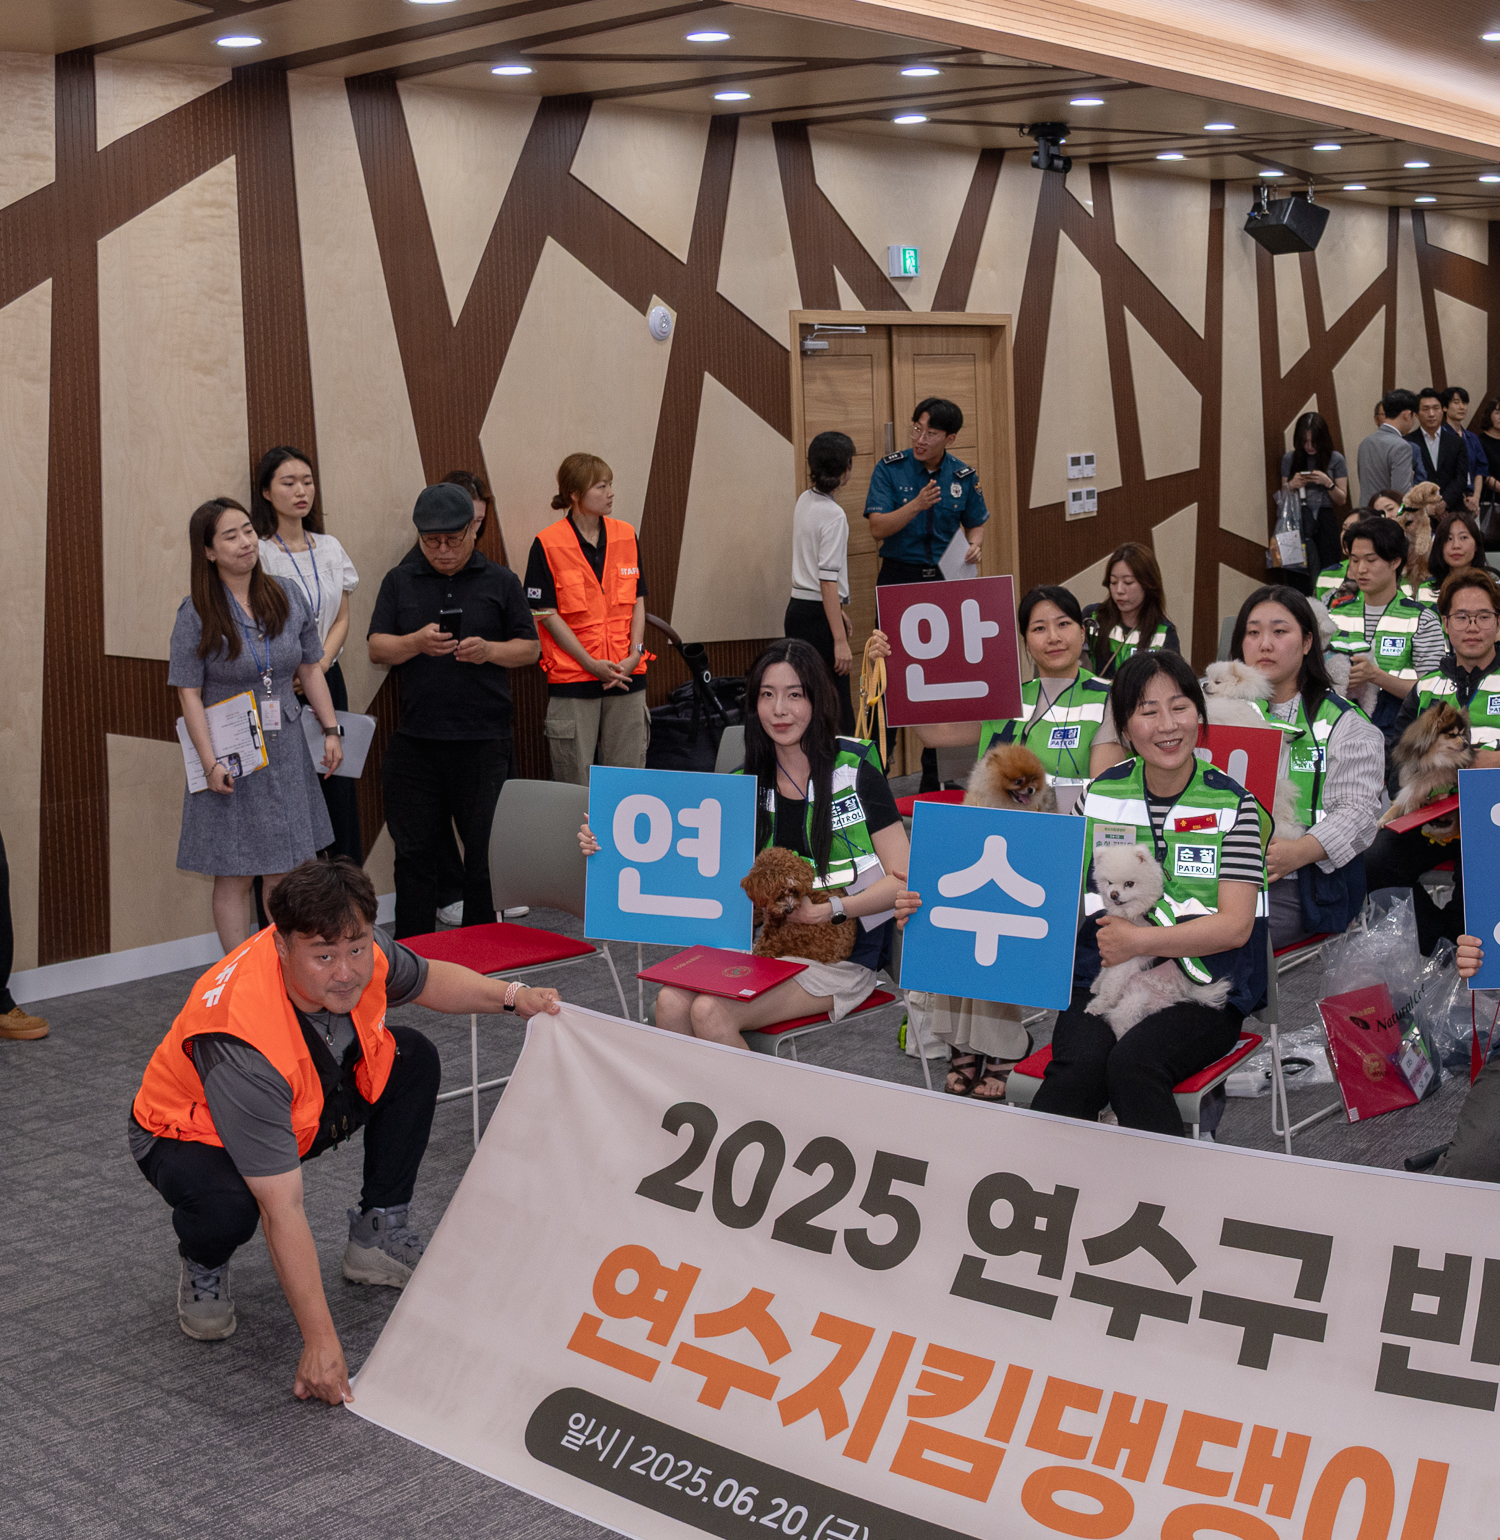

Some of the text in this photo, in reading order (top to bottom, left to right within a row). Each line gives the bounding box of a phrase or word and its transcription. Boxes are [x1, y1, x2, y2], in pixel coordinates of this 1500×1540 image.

[900, 598, 1000, 702] 안
[612, 794, 723, 919] 연
[930, 835, 1049, 966] 수
[1179, 864, 1213, 874] PATROL
[1180, 848, 1214, 863] 순찰
[634, 1101, 930, 1271] 2025
[948, 1170, 1334, 1371] 연수구
[560, 1412, 622, 1463] 일시
